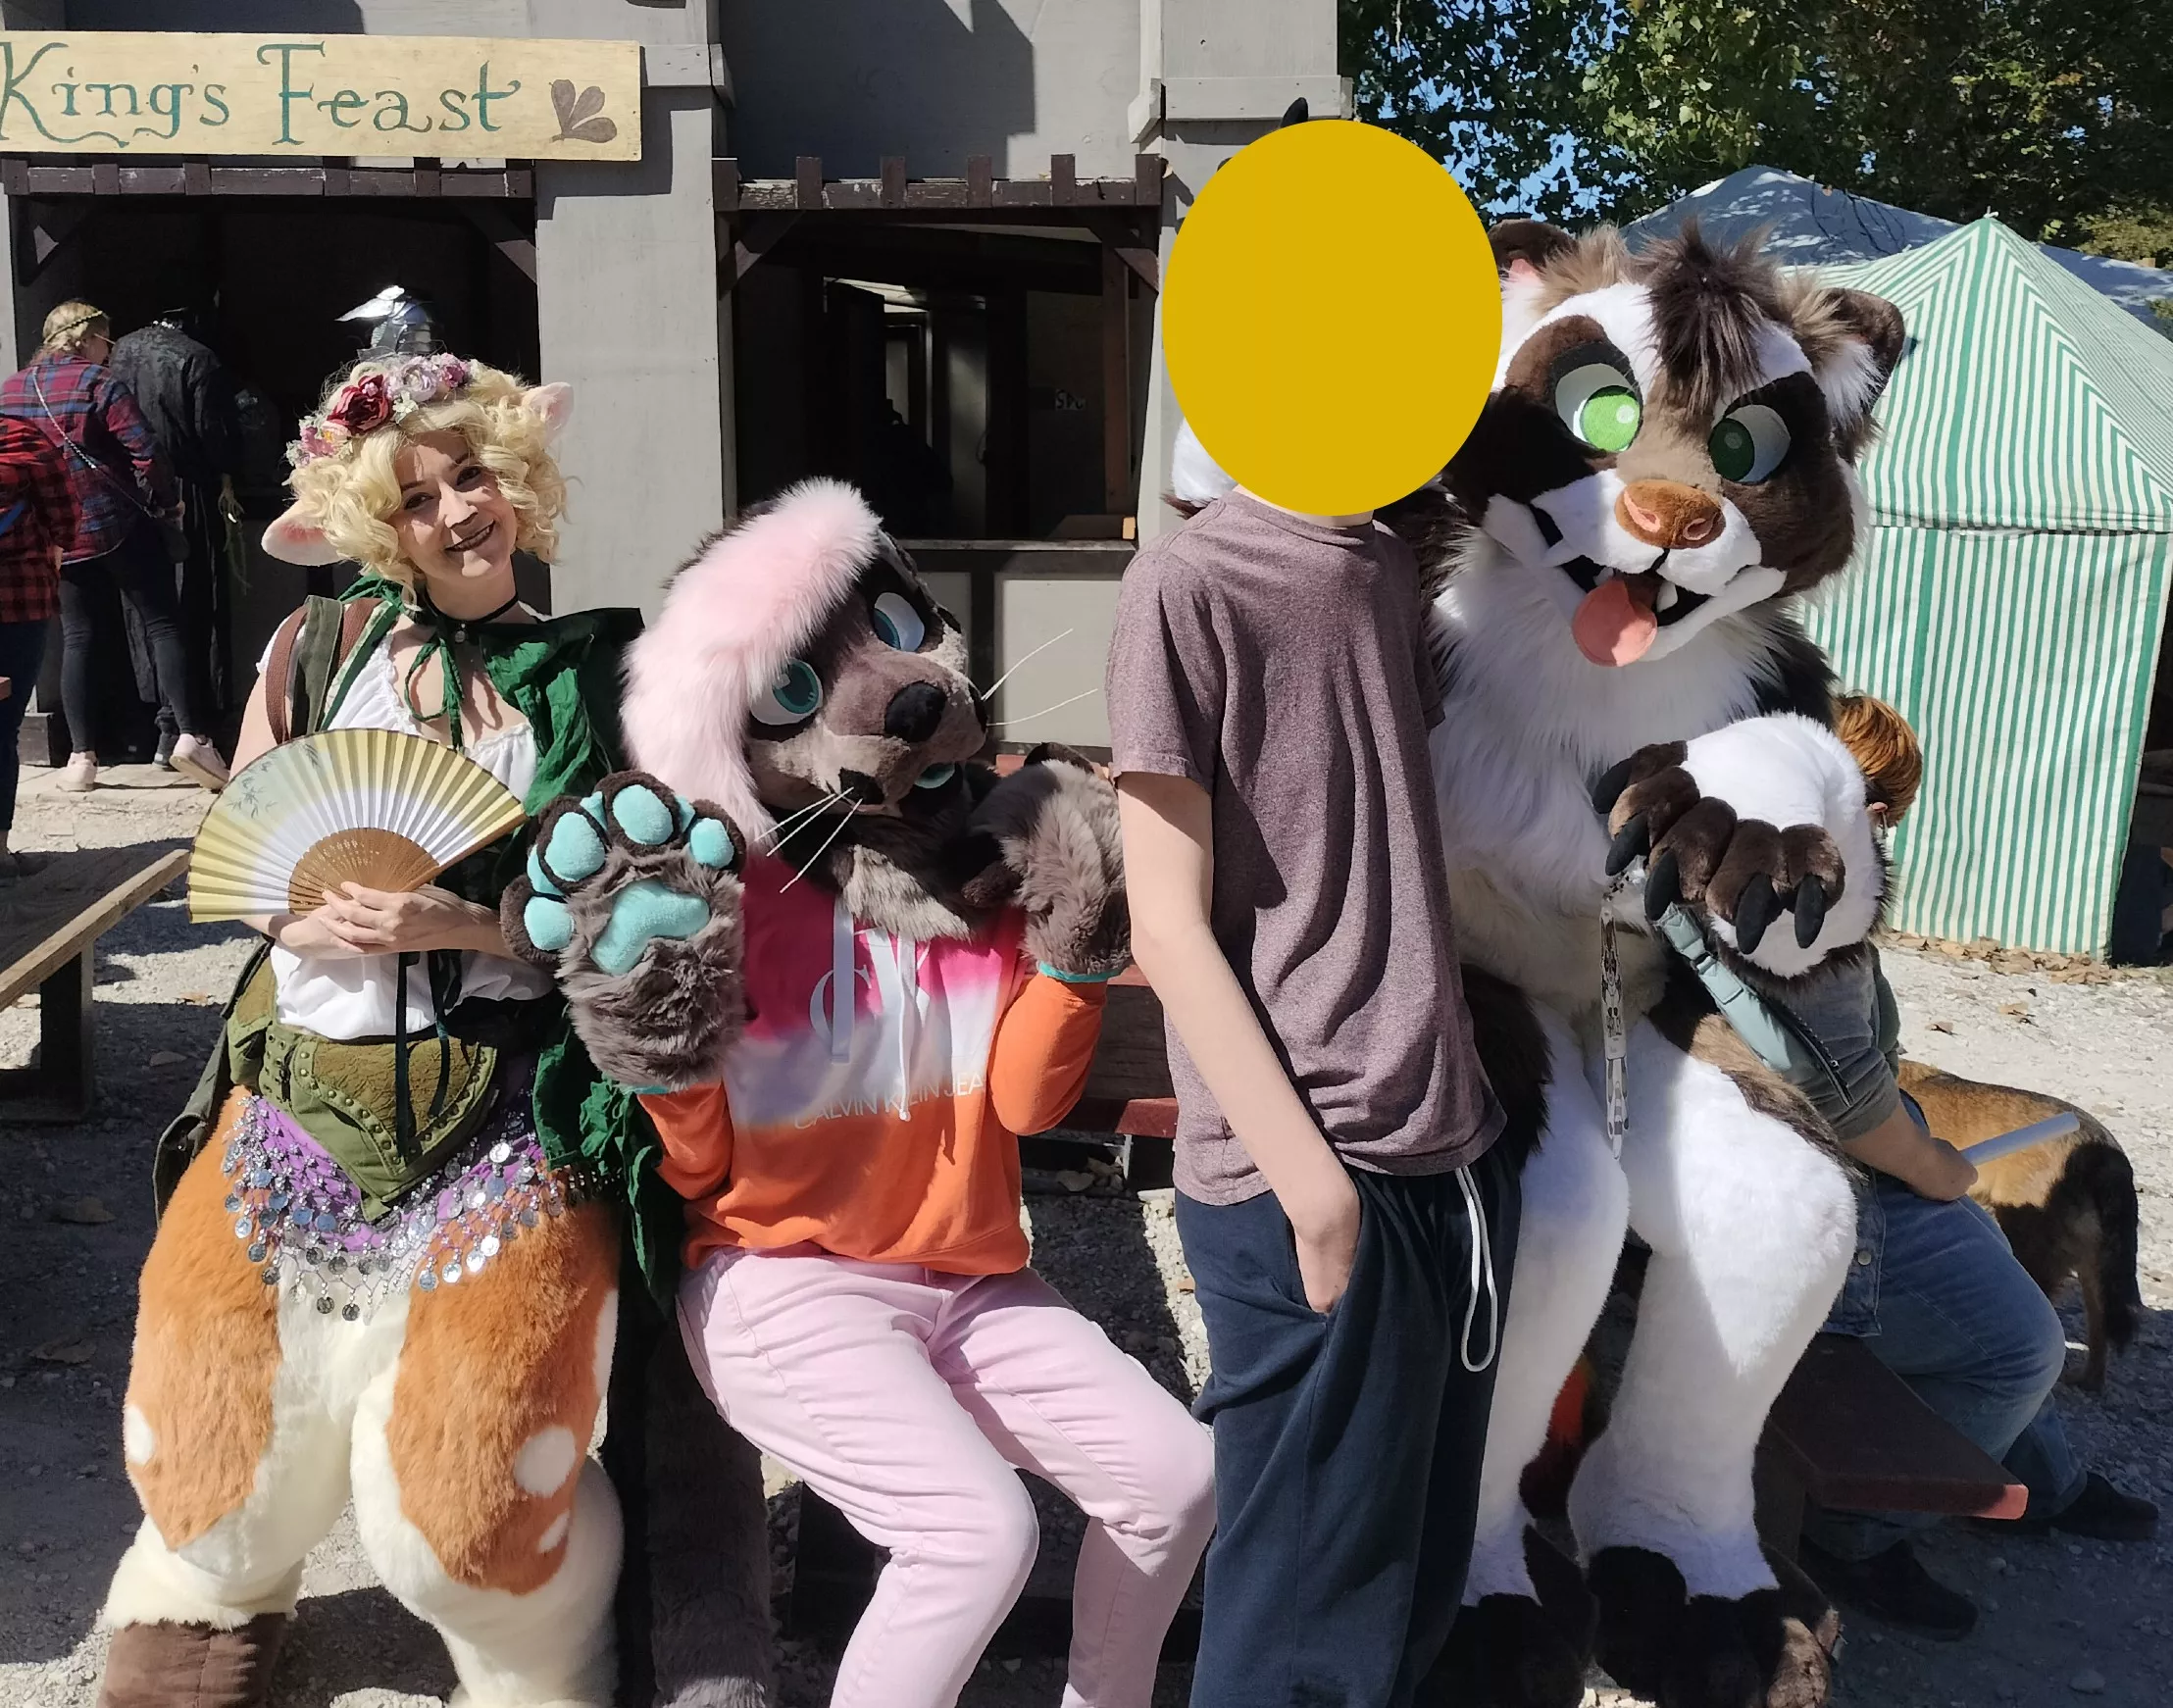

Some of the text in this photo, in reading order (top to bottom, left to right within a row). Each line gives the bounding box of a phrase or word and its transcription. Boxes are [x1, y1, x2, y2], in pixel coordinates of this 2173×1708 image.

[0, 41, 521, 148] King's Feast
[794, 1091, 878, 1130] CALVIN
[943, 1072, 985, 1096] JEA
